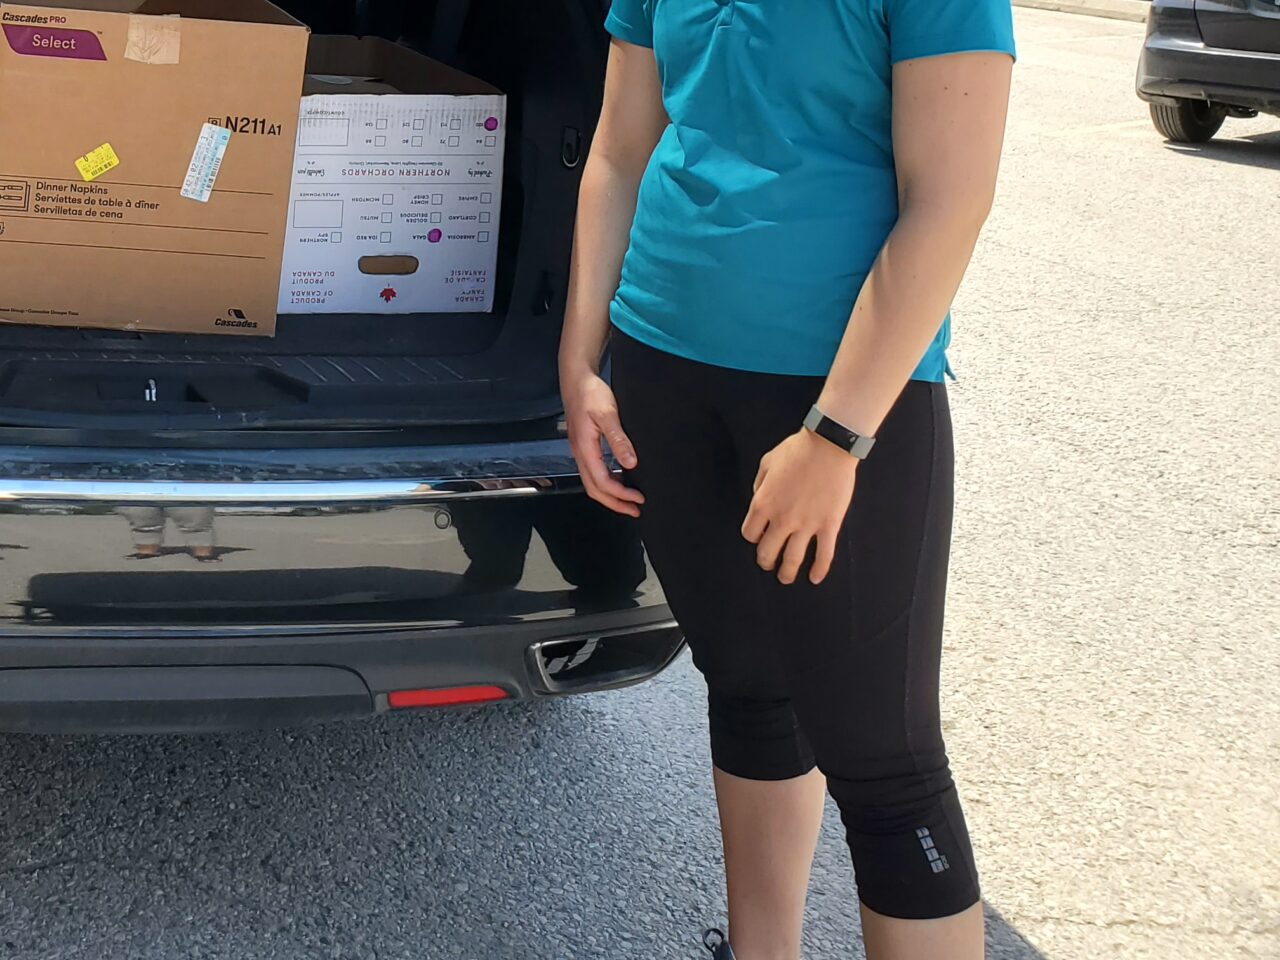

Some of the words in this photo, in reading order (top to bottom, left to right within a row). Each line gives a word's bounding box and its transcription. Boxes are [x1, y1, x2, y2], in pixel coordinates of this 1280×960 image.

[2, 11, 49, 25] Cascades
[49, 15, 67, 24] PRO
[32, 34, 77, 50] Select
[341, 168, 395, 176] ORCHARDS
[399, 169, 450, 177] NORTHERN
[36, 181, 68, 192] Dinner
[70, 183, 108, 195] Napkins
[35, 193, 81, 205] Serviettes
[84, 195, 96, 205] de
[98, 196, 123, 208] table
[125, 198, 132, 208] à
[34, 204, 82, 216] Servilletas
[85, 206, 96, 217] de
[100, 210, 123, 219] cena
[214, 318, 258, 328] Cascades
